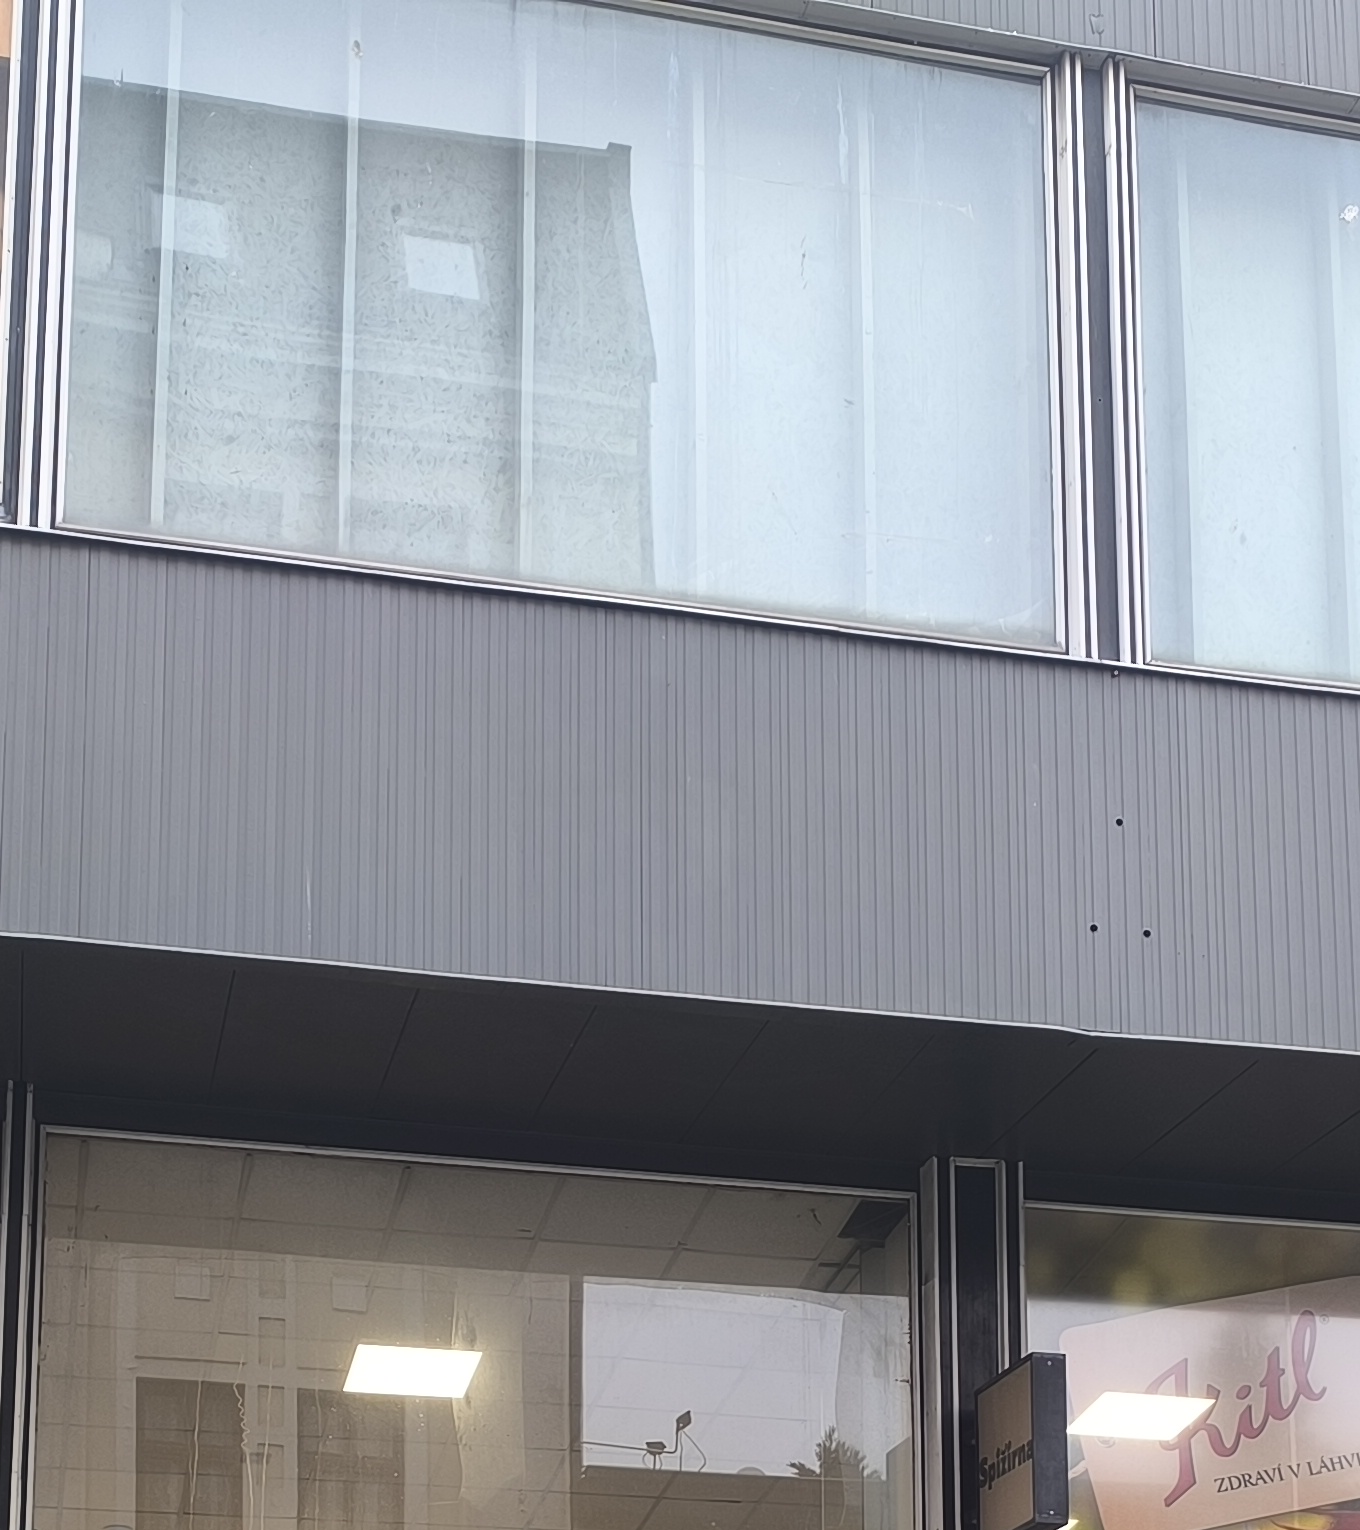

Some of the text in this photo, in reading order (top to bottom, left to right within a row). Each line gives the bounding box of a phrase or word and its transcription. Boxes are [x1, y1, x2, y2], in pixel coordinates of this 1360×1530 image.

[1140, 1308, 1328, 1508] Kitl
[1213, 1466, 1284, 1494] ZDRAVÍ
[1288, 1462, 1302, 1480] V
